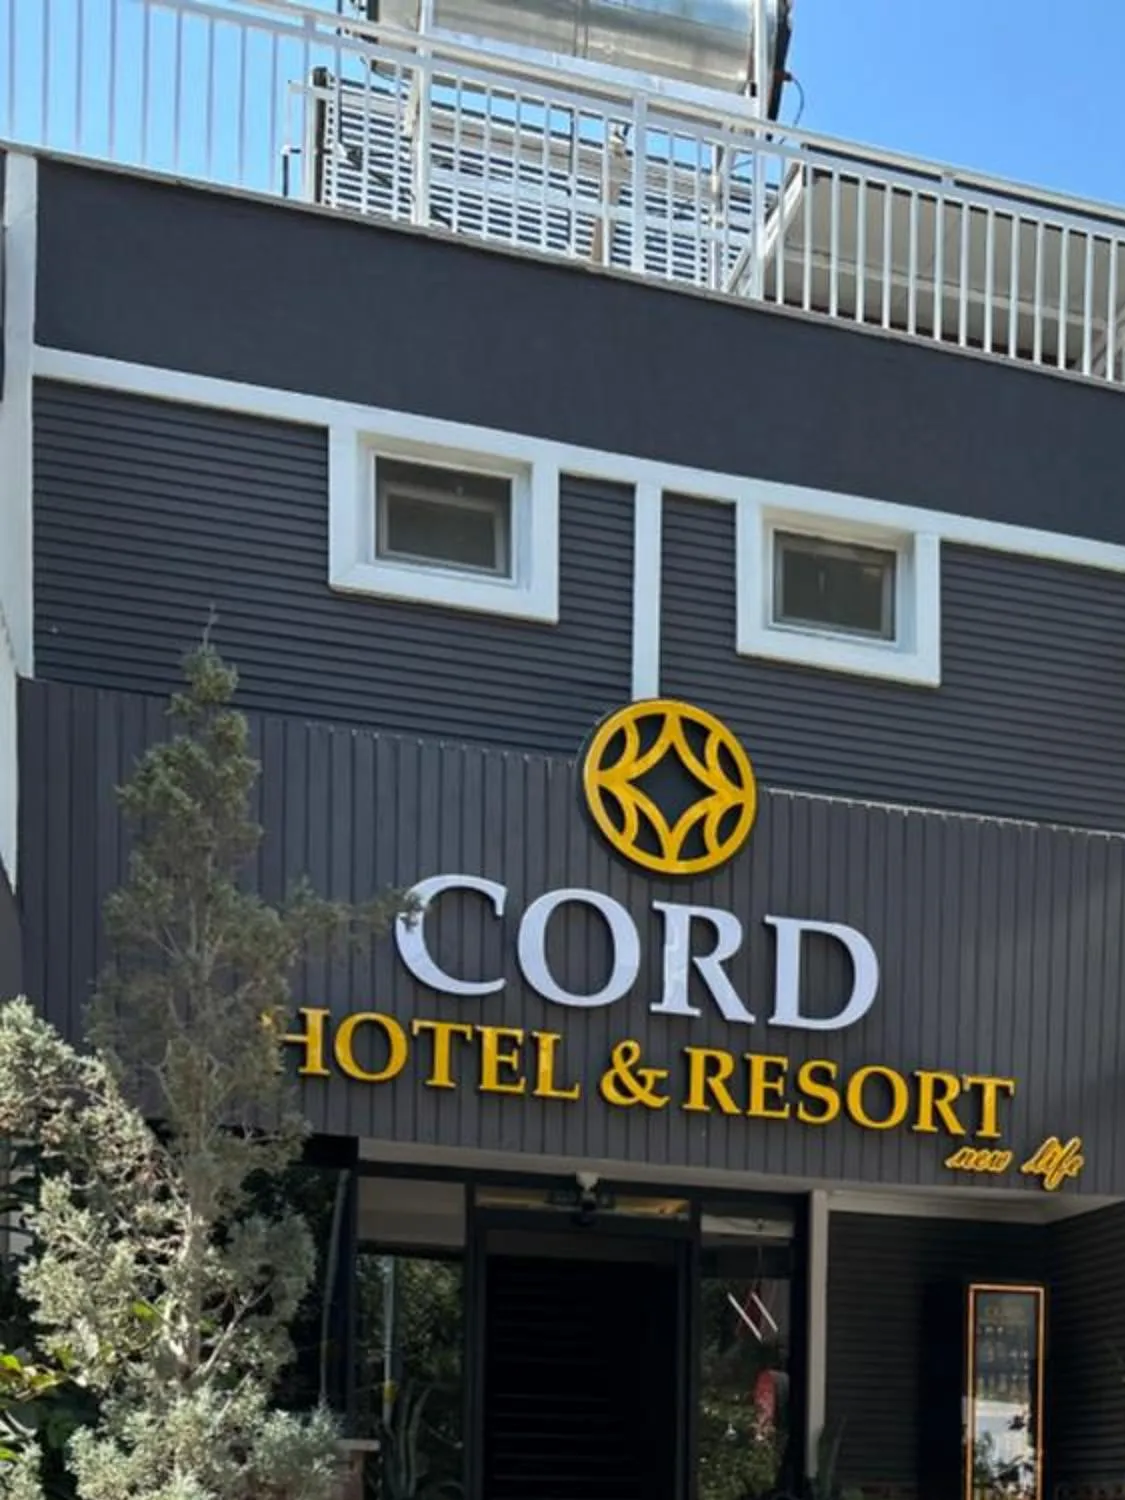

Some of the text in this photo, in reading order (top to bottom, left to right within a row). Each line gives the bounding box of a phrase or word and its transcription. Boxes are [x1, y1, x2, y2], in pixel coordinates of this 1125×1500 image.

[396, 874, 880, 1030] CORD
[600, 1040, 669, 1109] &
[683, 1046, 1015, 1139] RESORT
[945, 1136, 1084, 1190] new life
